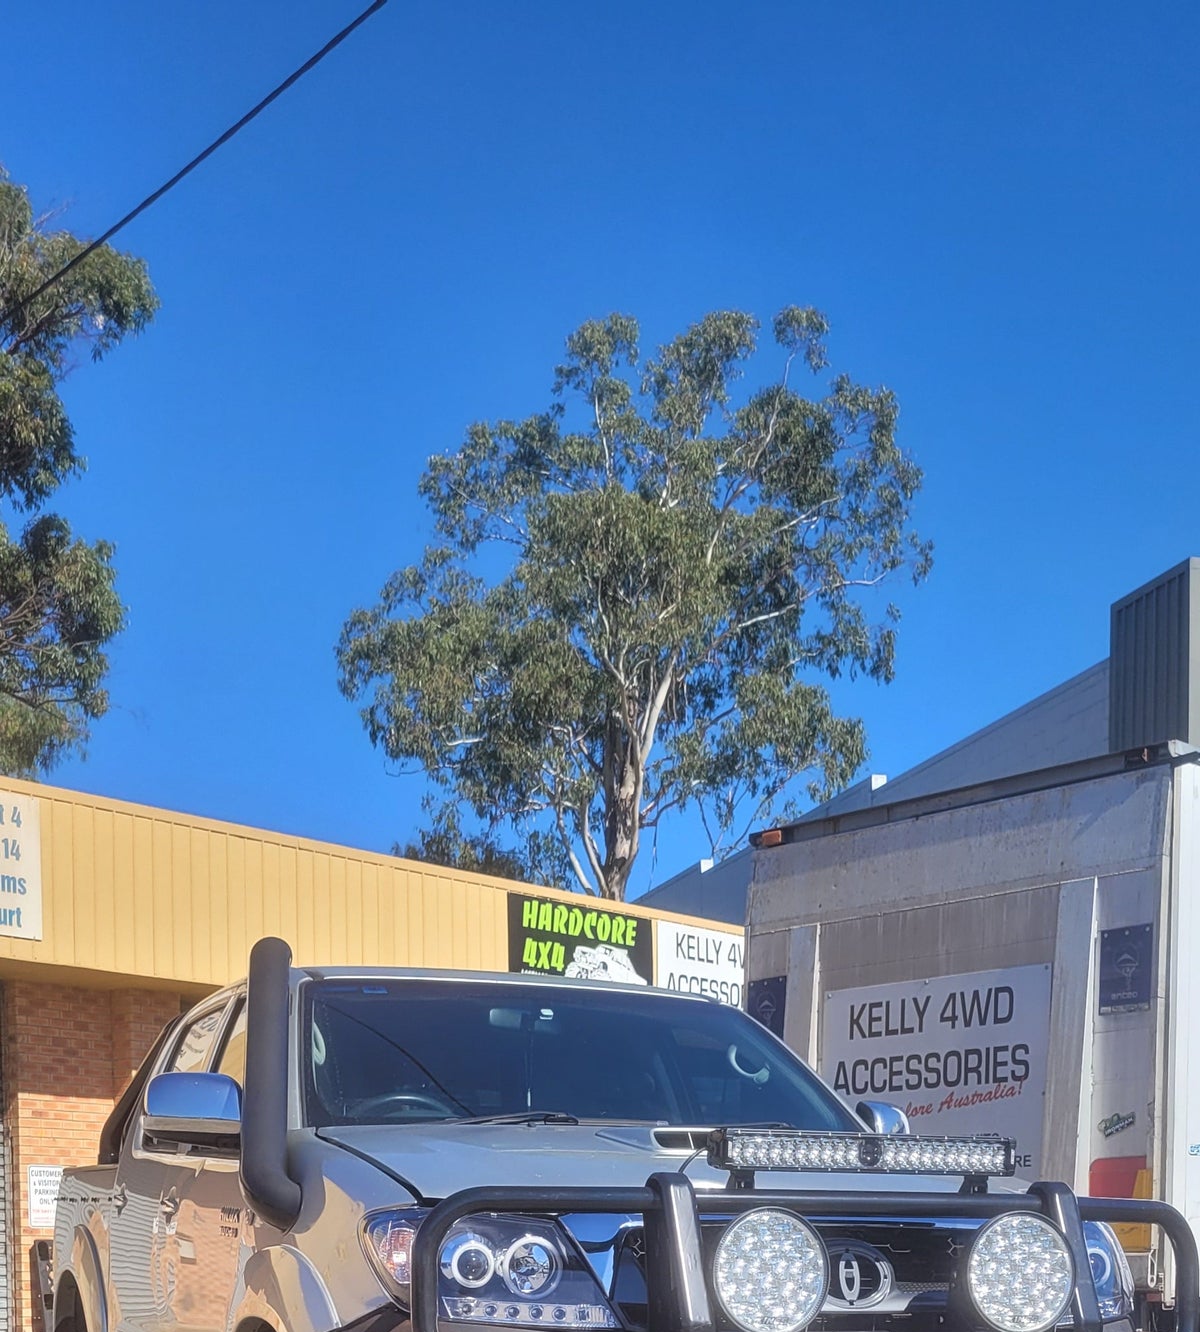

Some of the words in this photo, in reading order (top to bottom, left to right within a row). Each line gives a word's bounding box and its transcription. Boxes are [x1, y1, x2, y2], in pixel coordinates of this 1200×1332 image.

[11, 806, 22, 828] 4
[522, 899, 638, 946] HARDCORE
[522, 938, 565, 972] 4X4
[675, 932, 722, 965] KELLY
[667, 972, 745, 1007] ACCESSO
[849, 995, 931, 1040] KELLY
[940, 986, 1014, 1030] 4WD
[833, 1044, 1030, 1096] ACCESSORIES
[901, 1101, 933, 1118] lore
[938, 1076, 1025, 1113] Australia!
